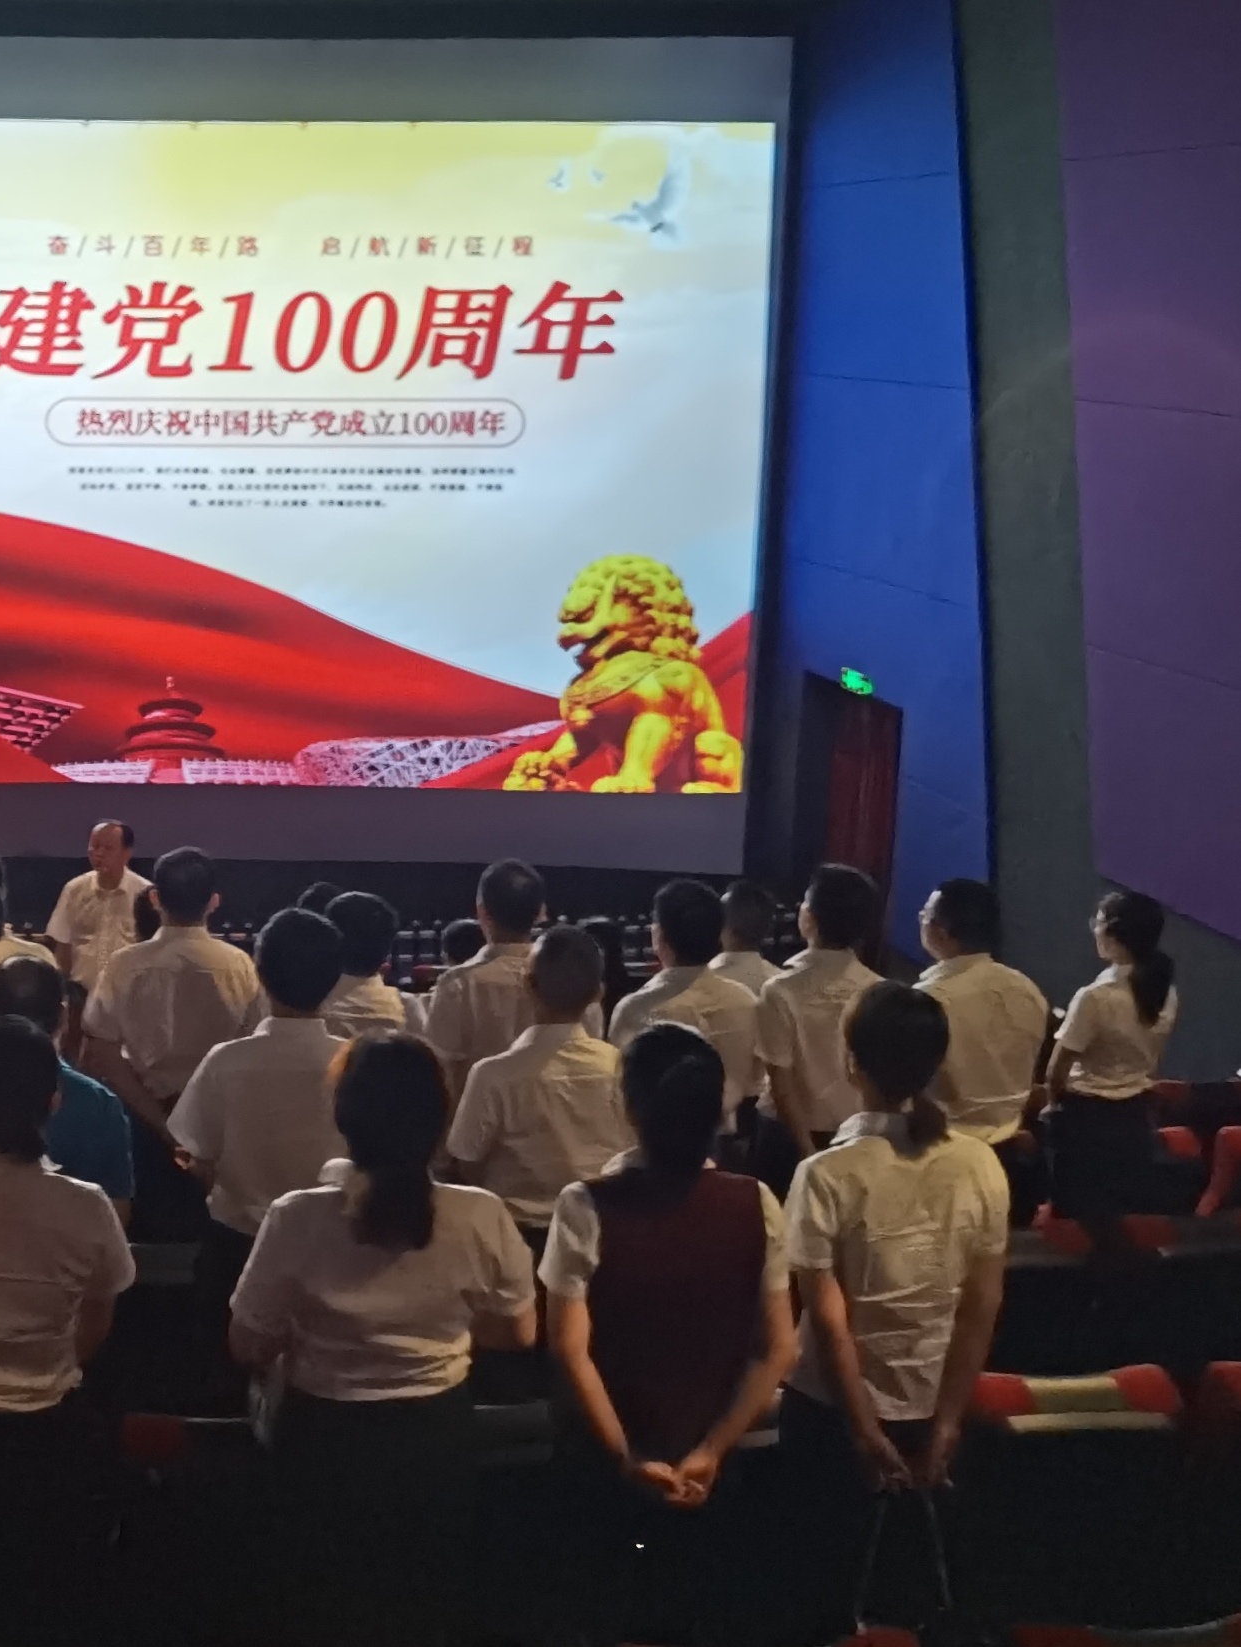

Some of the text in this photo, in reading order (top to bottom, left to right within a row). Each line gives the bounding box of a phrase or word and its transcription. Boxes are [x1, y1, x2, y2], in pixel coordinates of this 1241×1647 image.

[76, 408, 507, 437] 热烈庆祝中国共产党成立100周年
